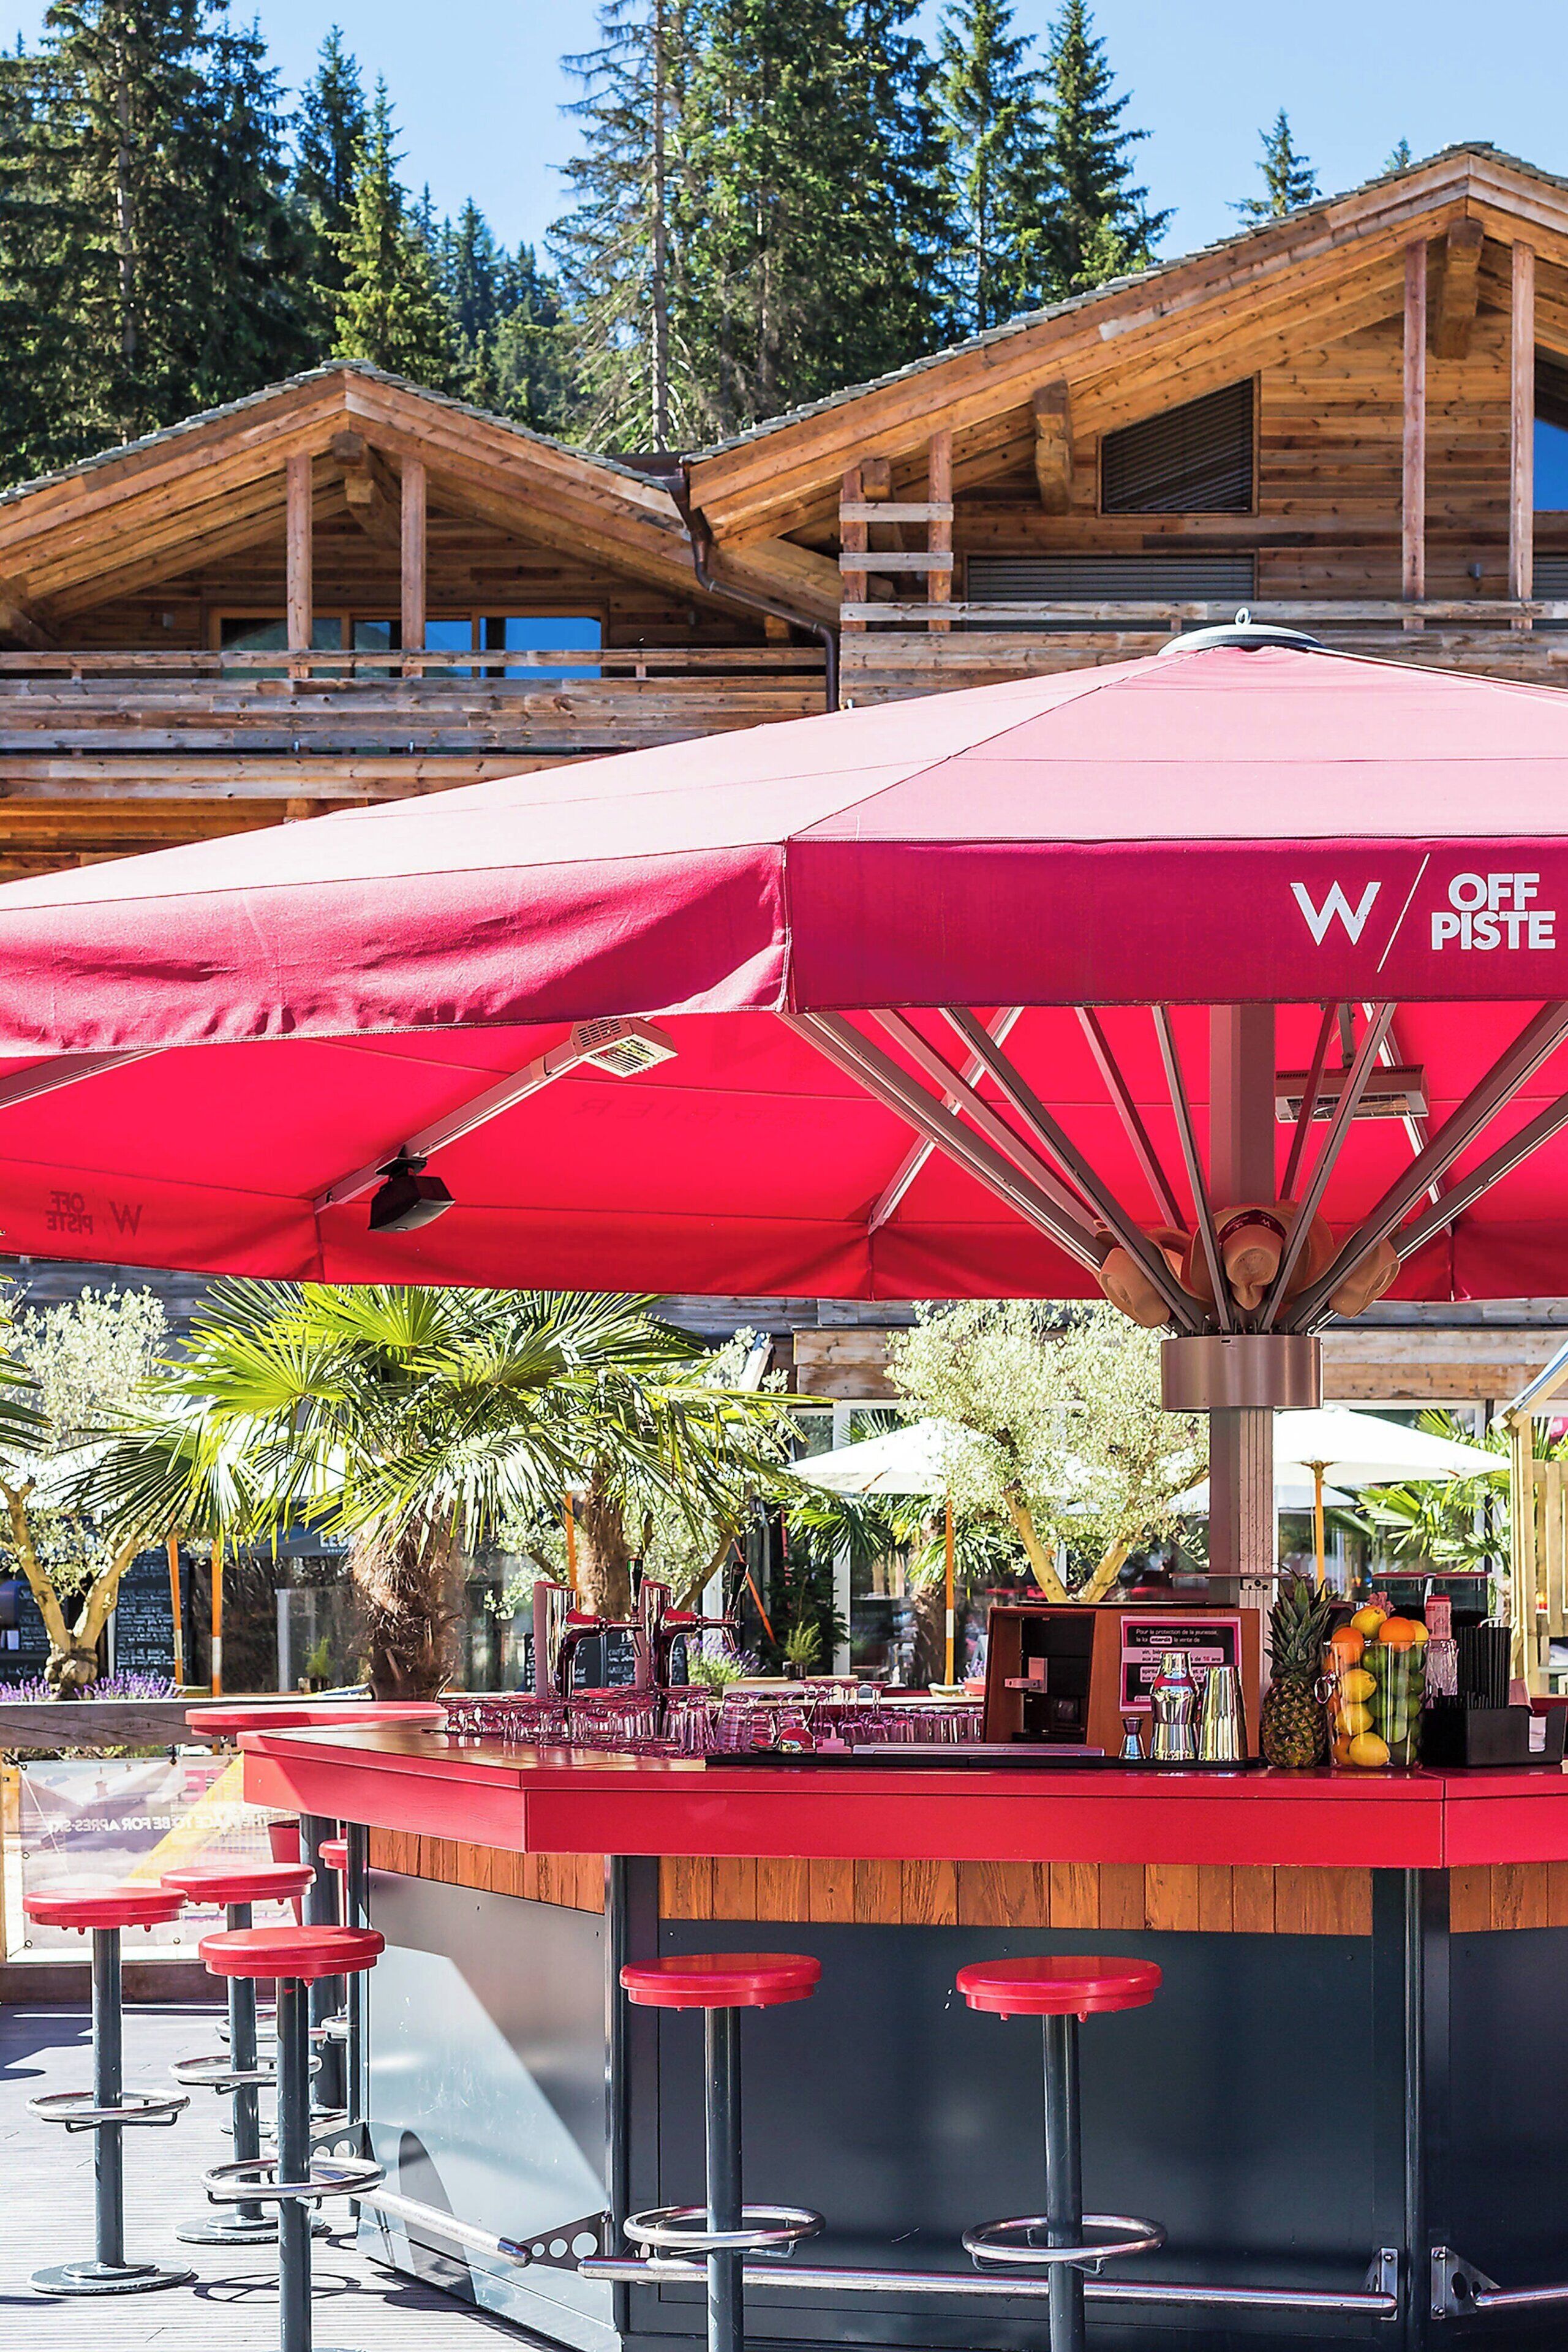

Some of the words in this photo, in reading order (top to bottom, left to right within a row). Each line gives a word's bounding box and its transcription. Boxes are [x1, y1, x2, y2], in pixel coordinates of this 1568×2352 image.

[1448, 873, 1540, 911] OFF
[1290, 880, 1381, 946] W
[1431, 911, 1556, 950] PISTE
